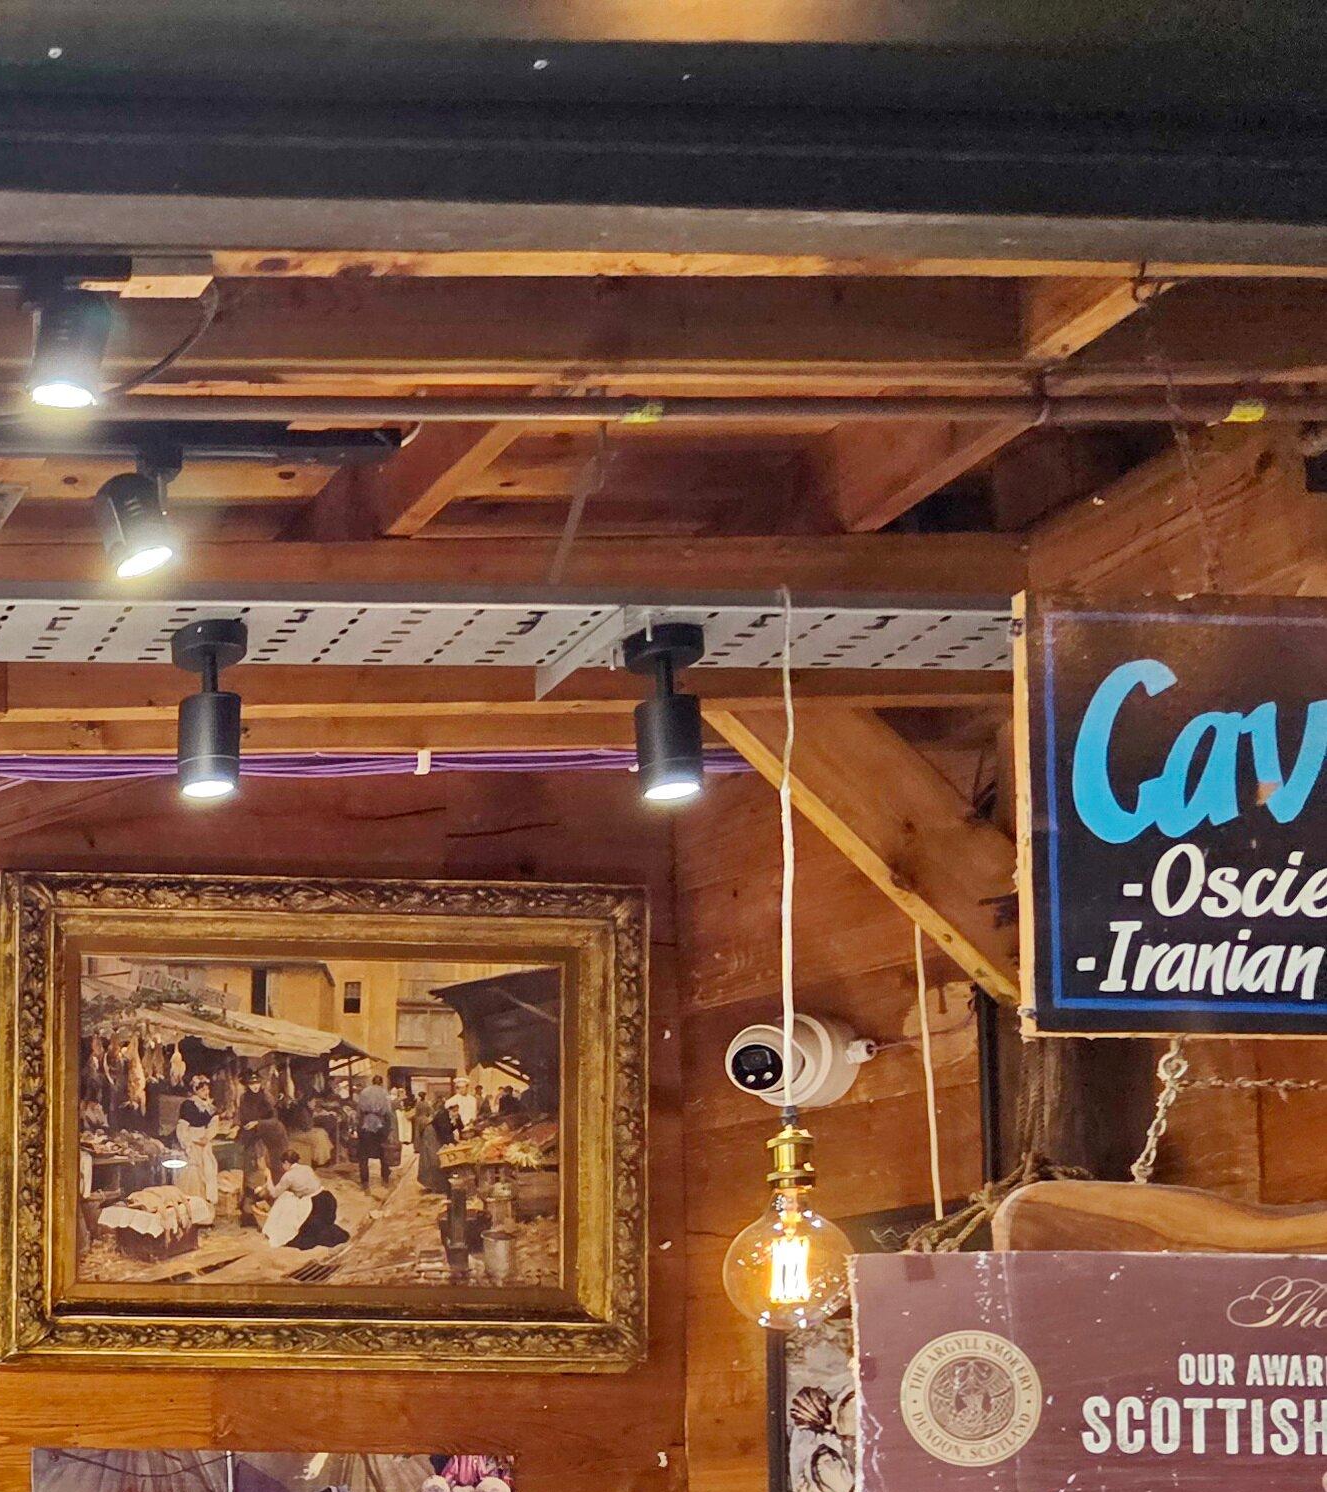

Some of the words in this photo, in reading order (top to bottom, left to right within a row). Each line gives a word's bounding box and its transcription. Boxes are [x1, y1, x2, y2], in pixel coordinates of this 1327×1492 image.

[909, 1363, 930, 1391] THE
[927, 1336, 979, 1362] ARGYLL
[984, 1338, 1034, 1391] SMOKERY
[1178, 1352, 1236, 1387] OUR
[970, 1412, 1031, 1459] SCOTLAND
[1081, 1396, 1327, 1456] SCOTTISH
